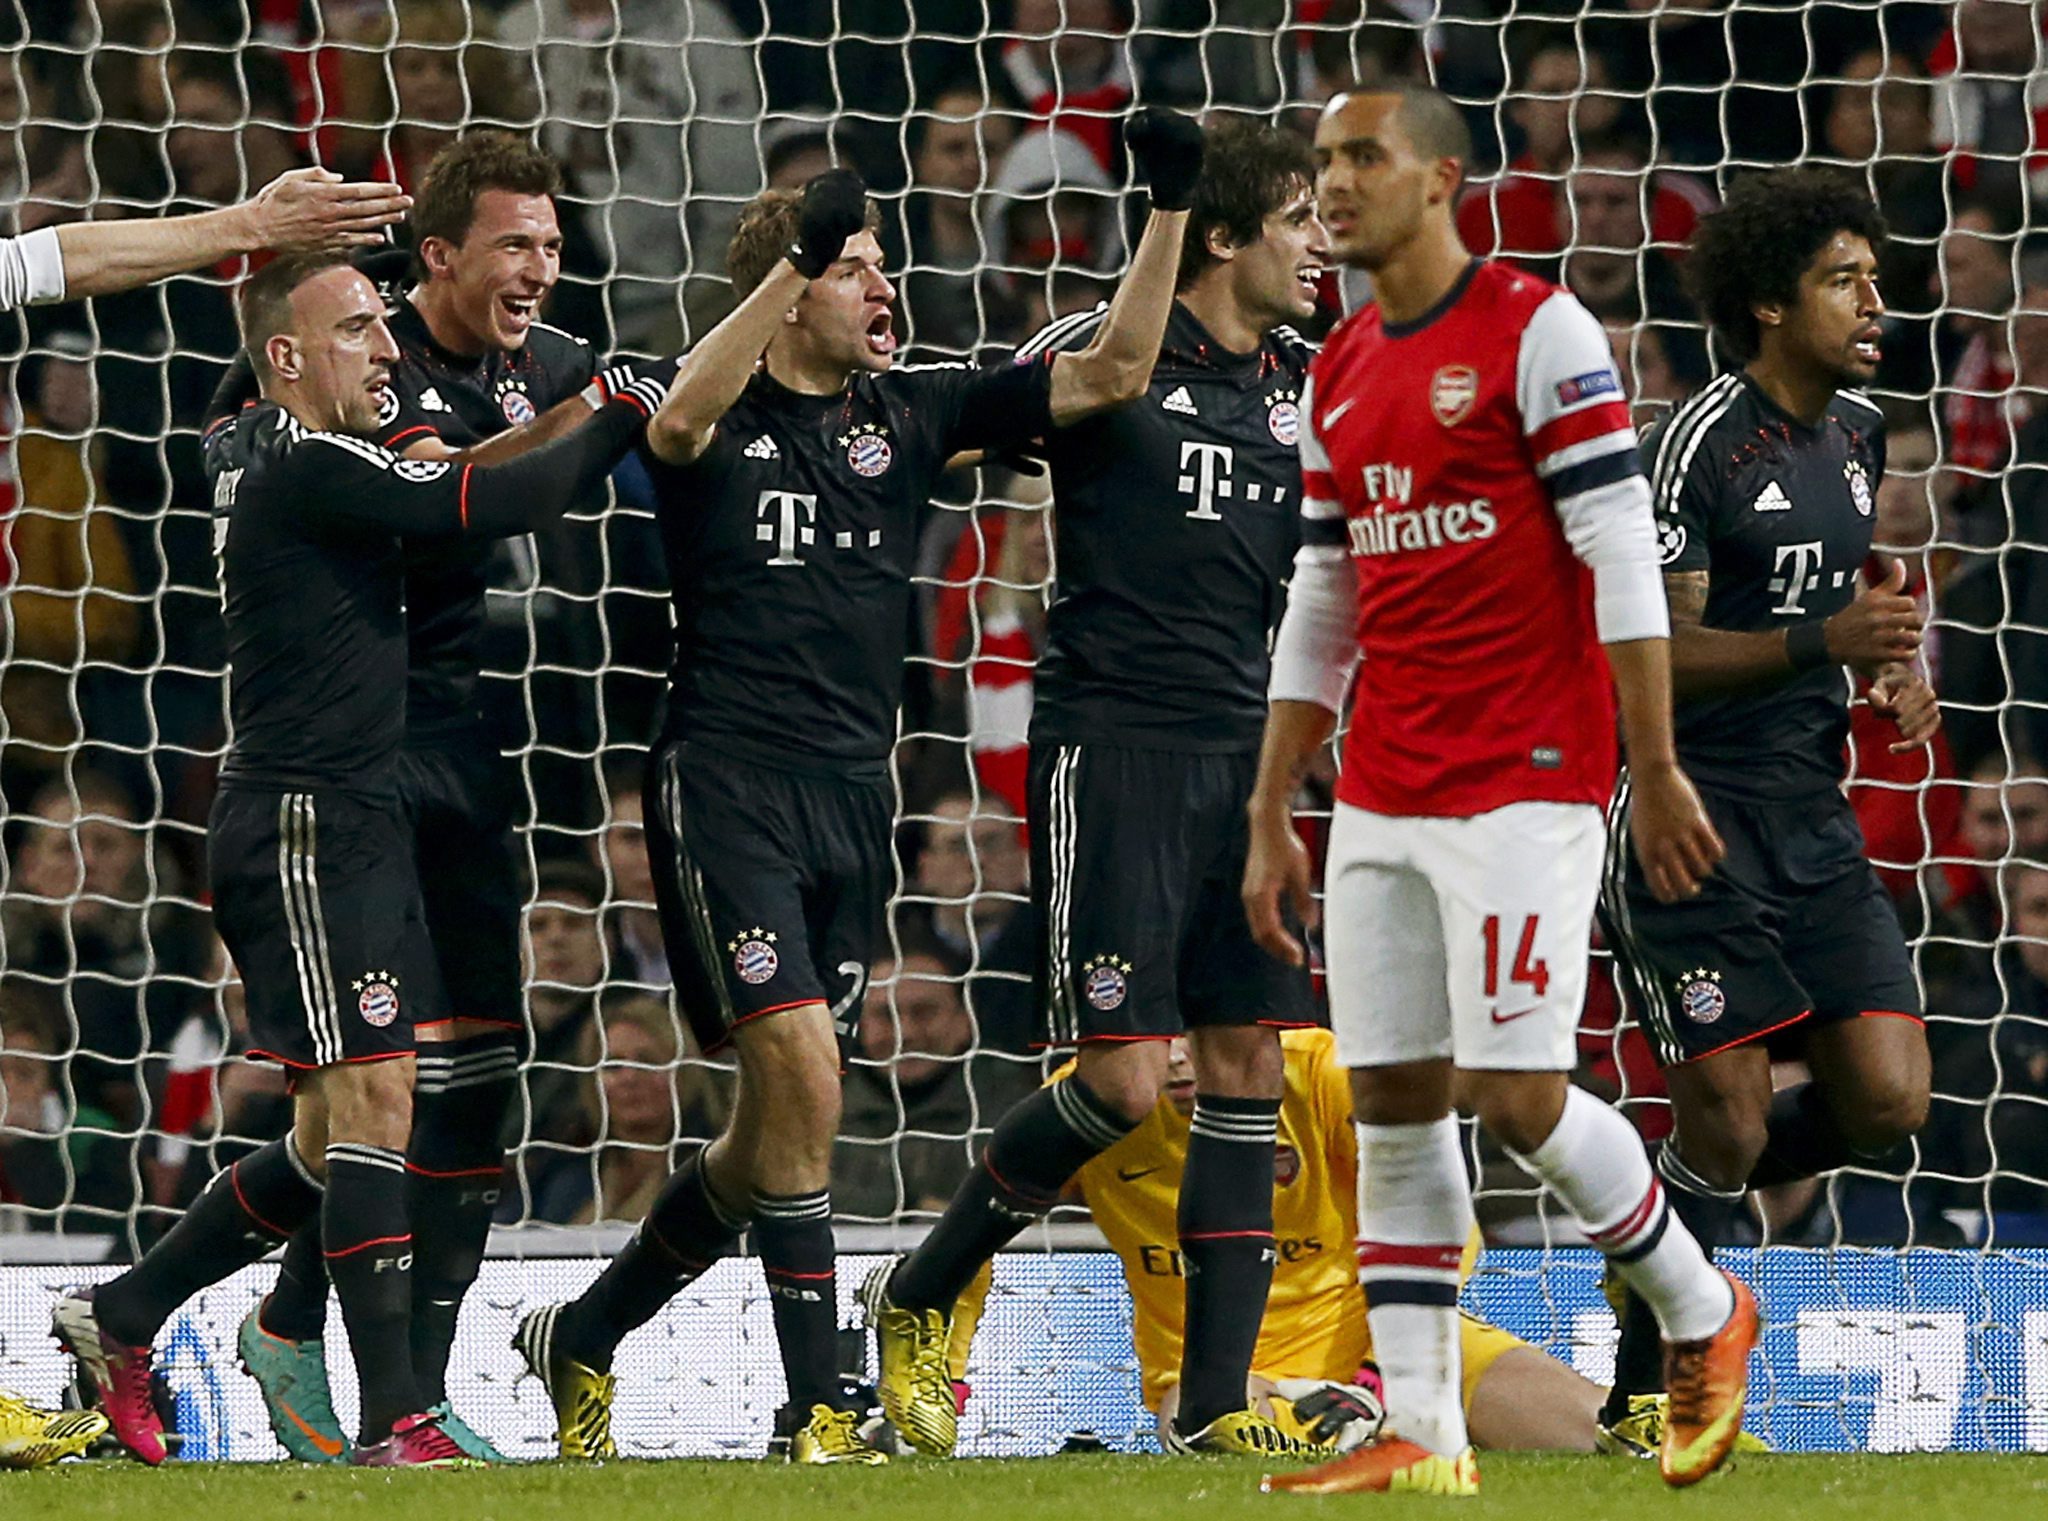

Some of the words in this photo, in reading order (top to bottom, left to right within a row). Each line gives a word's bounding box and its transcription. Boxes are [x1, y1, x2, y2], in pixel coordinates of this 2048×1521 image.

[1178, 441, 1233, 521] T
[1362, 461, 1412, 504] Fly
[756, 490, 817, 566] T
[1347, 498, 1497, 557] mirates
[1768, 541, 1823, 614] T
[1482, 914, 1549, 997] 14
[831, 960, 865, 1037] 2
